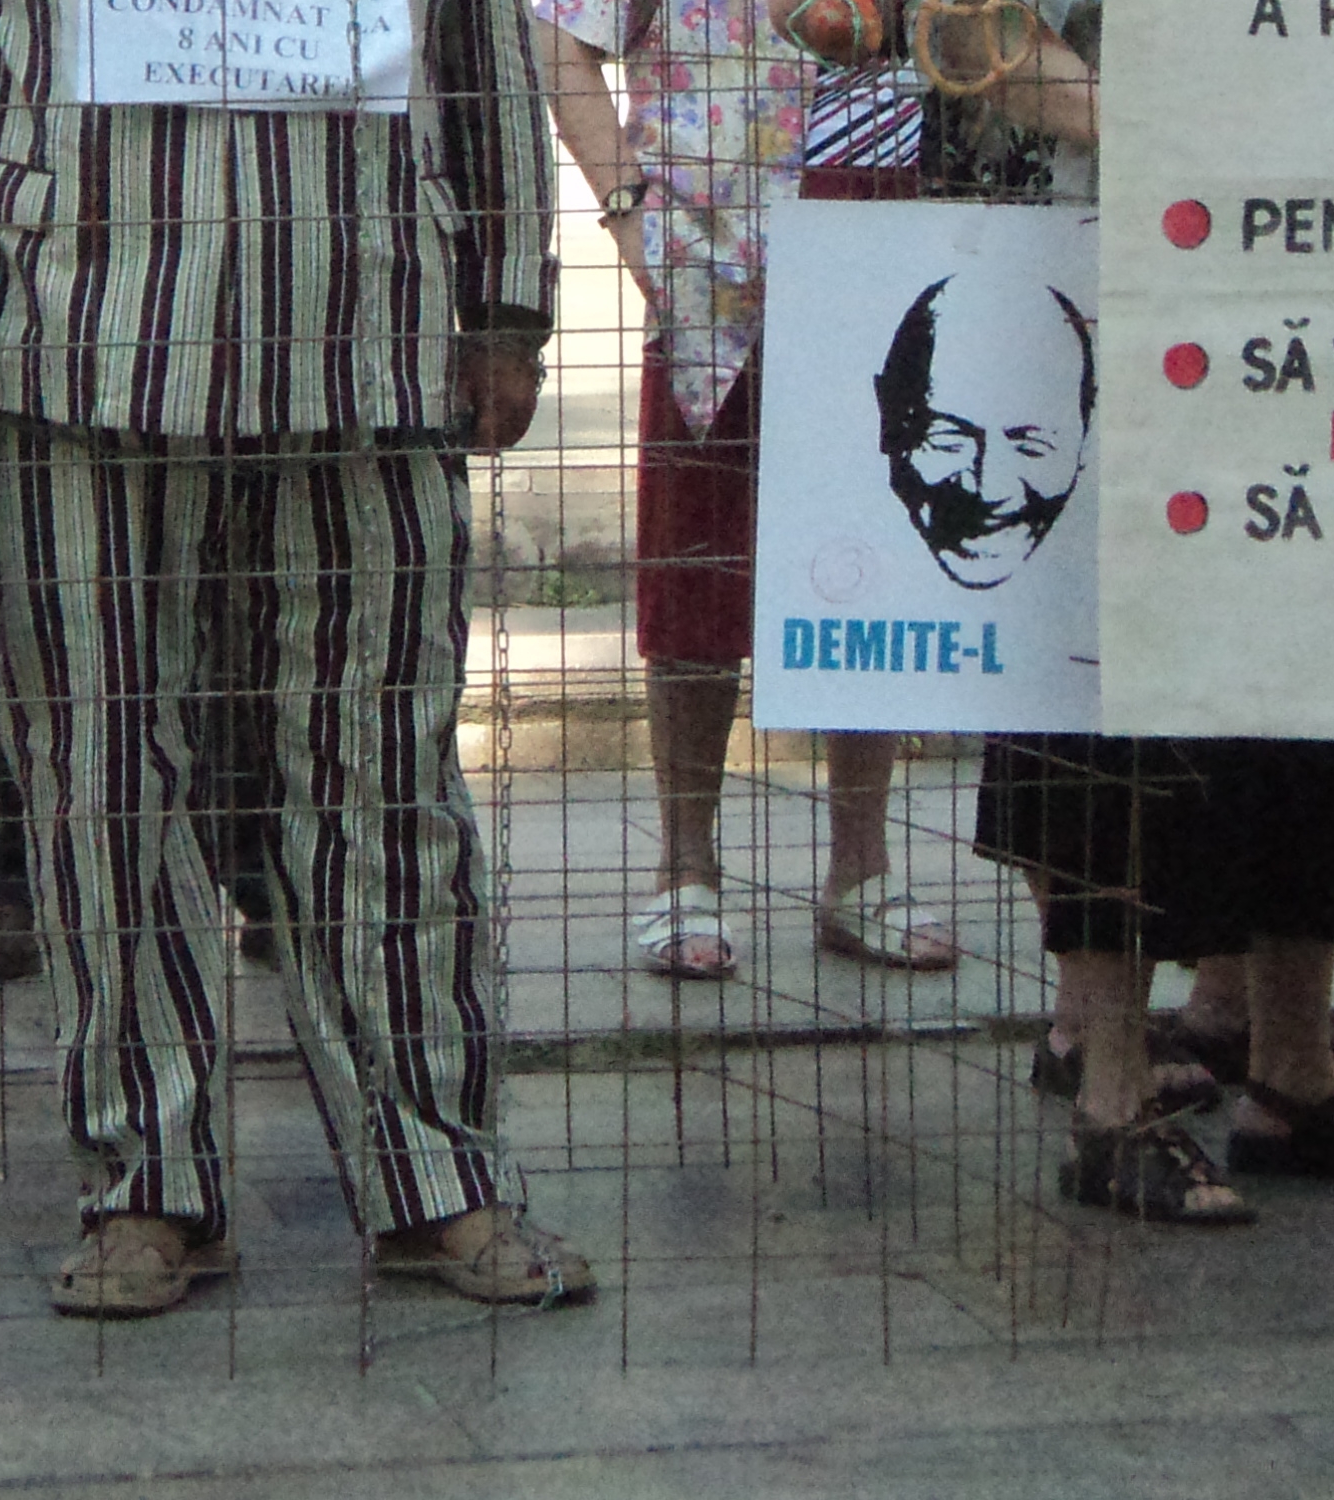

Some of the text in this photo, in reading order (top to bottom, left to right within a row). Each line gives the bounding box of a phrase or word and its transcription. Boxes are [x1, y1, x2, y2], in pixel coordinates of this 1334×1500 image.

[178, 27, 319, 61] 8 ANI CU
[1241, 316, 1316, 393] SĂ
[1244, 463, 1323, 542] SĂ
[782, 618, 1005, 675] DEMITE-L
